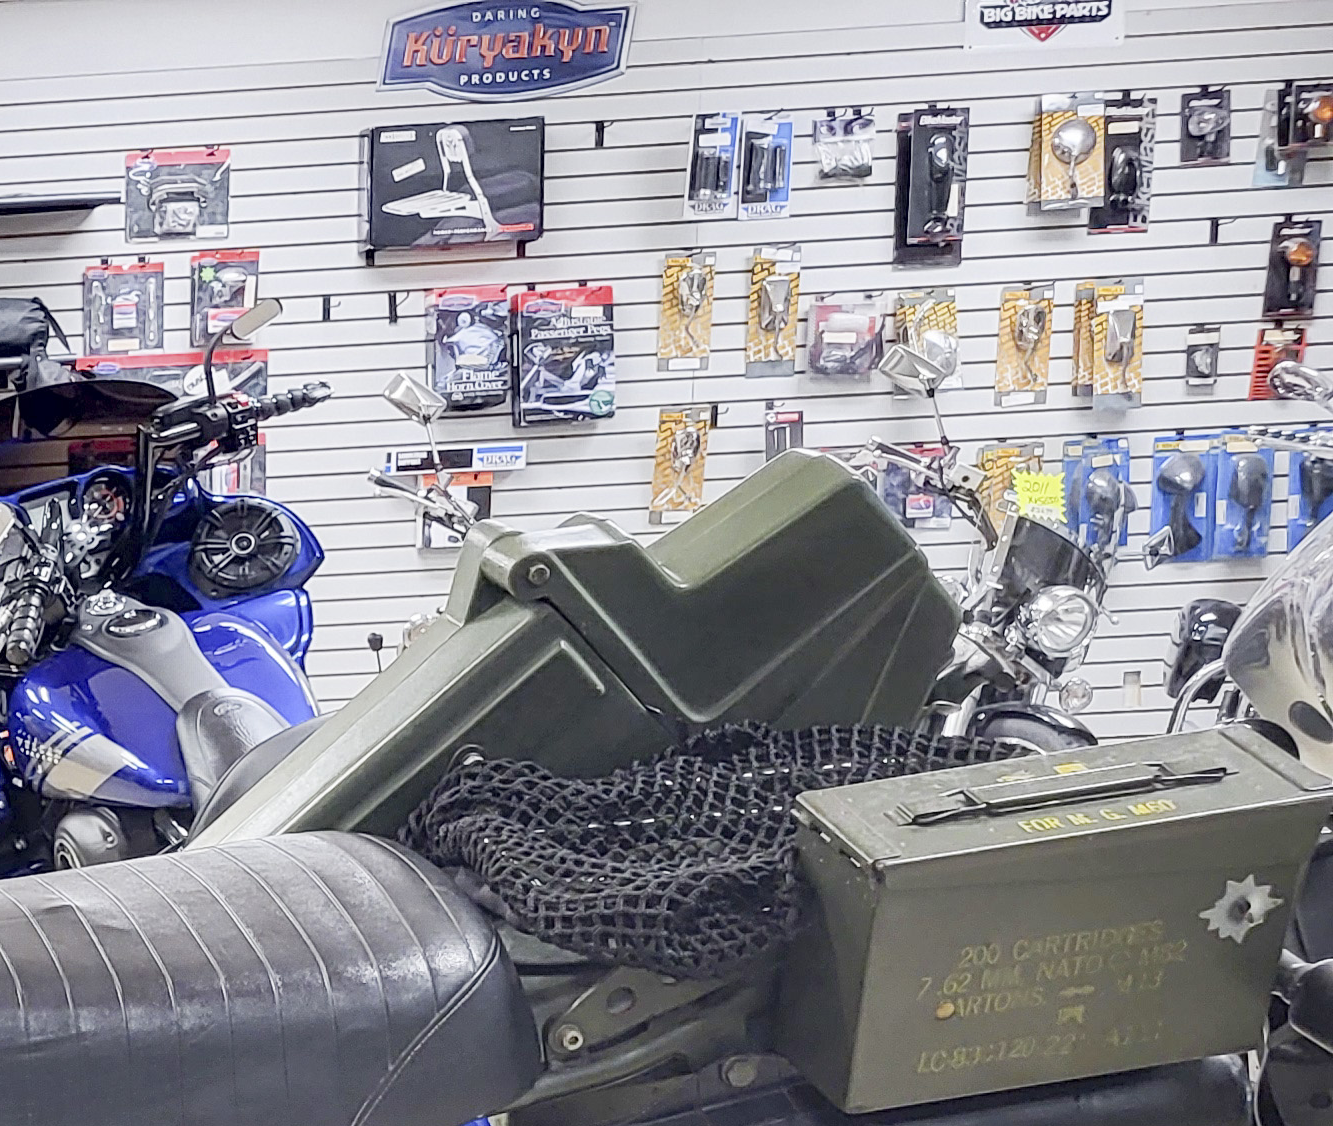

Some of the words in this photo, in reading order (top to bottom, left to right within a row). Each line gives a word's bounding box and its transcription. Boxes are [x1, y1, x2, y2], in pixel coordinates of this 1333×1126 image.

[472, 7, 541, 22] DARING
[983, 7, 1013, 23] BIG
[1015, 4, 1053, 21] BIKE
[1055, 1, 1109, 18] PARTS
[402, 23, 610, 68] Küryakyn
[459, 68, 551, 86] PRODUCTS
[748, 204, 782, 214] DRAG
[446, 381, 473, 392] Horn
[1021, 480, 1050, 495] 2011
[1017, 816, 1065, 834] FOR
[1066, 812, 1098, 827] M.
[1099, 808, 1128, 821] G.
[1128, 799, 1177, 817] M60
[958, 943, 1002, 969] 200
[981, 965, 1023, 991] MM
[1036, 954, 1103, 982] NATO
[937, 987, 1045, 1020] ARTONS
